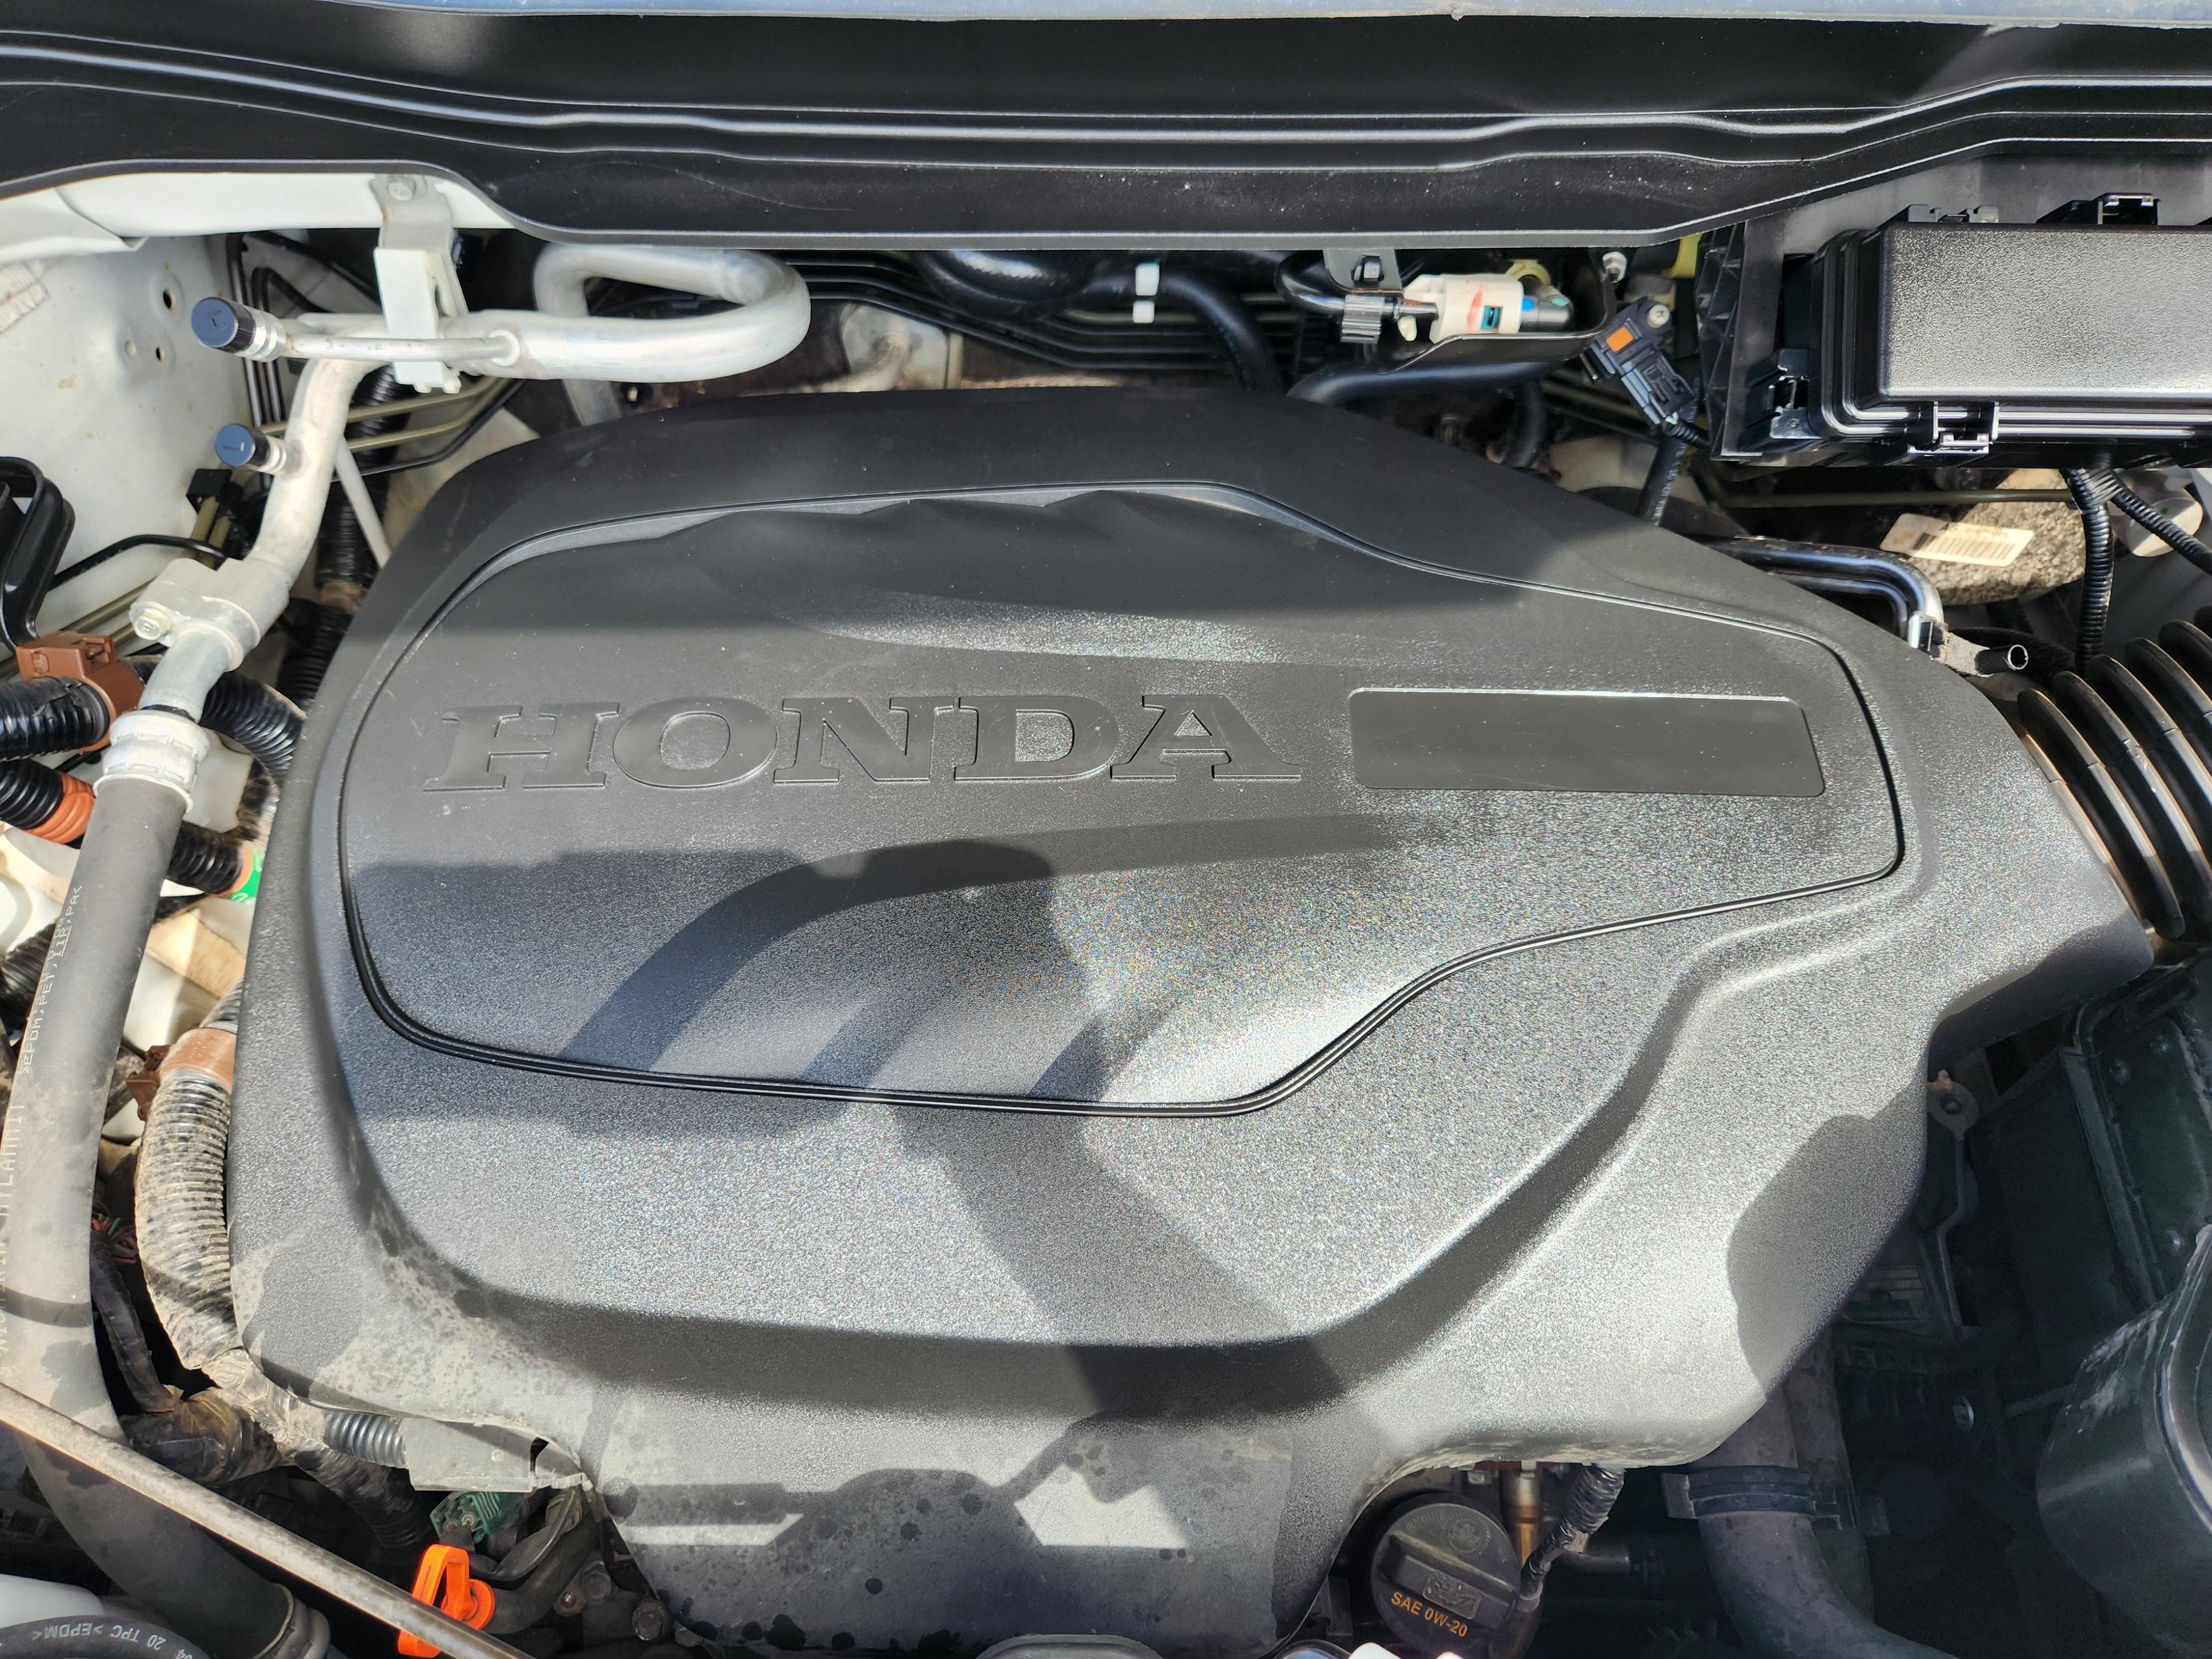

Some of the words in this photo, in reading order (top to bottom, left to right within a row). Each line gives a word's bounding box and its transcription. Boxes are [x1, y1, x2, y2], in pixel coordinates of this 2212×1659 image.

[423, 693, 1303, 794] HONDA
[1391, 1592, 1423, 1615] SAE
[1425, 1608, 1468, 1637] 0W-20
[111, 1625, 140, 1643] TPC
[147, 1634, 166, 1651] 20
